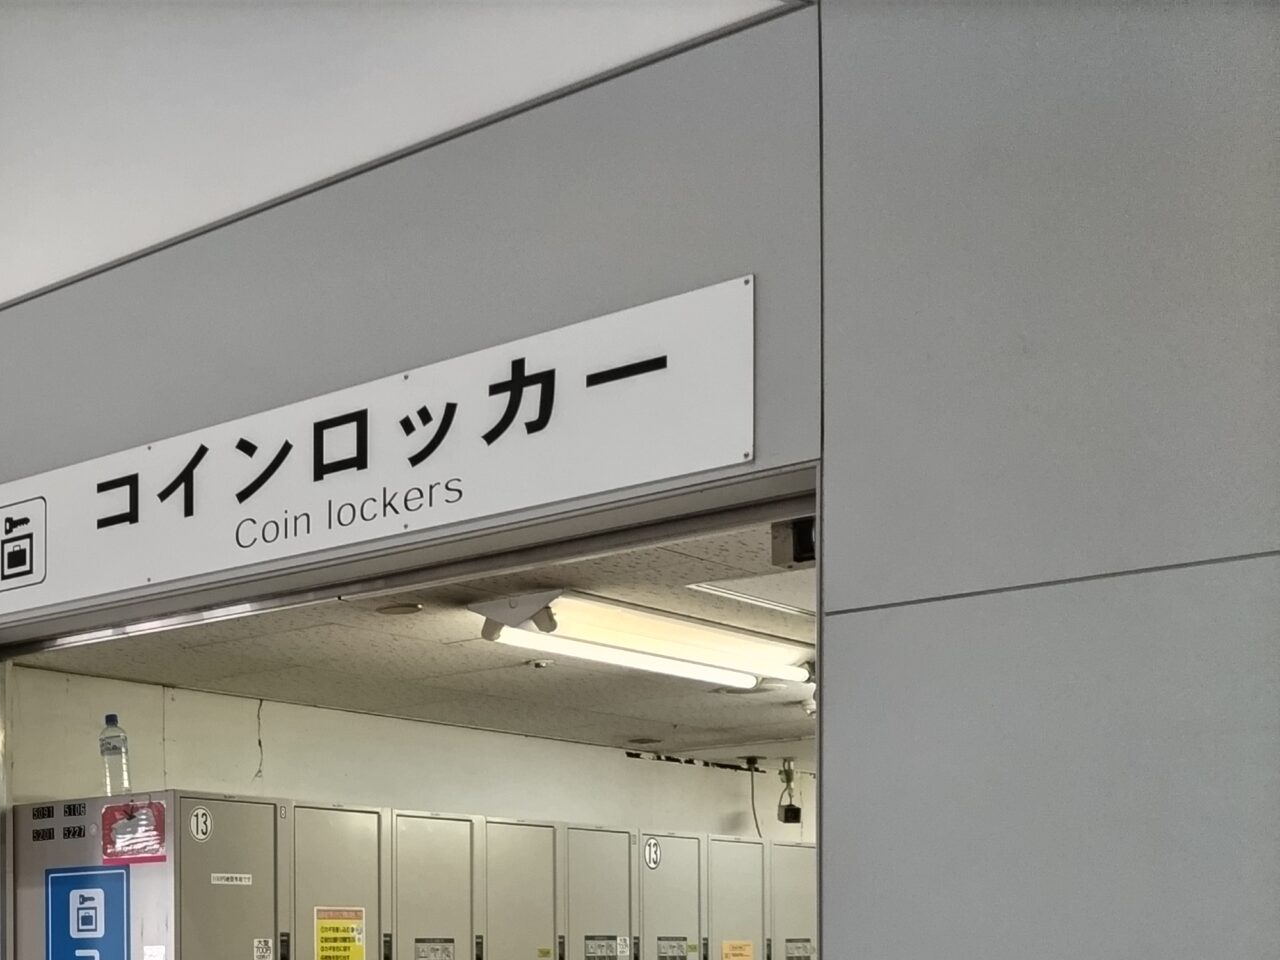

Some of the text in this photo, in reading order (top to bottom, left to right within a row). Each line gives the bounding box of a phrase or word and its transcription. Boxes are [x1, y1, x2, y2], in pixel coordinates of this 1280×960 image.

[96, 355, 668, 530] コインロッカー
[234, 474, 464, 550] Coin lockers
[193, 812, 209, 836] 13
[647, 841, 659, 866] 13
